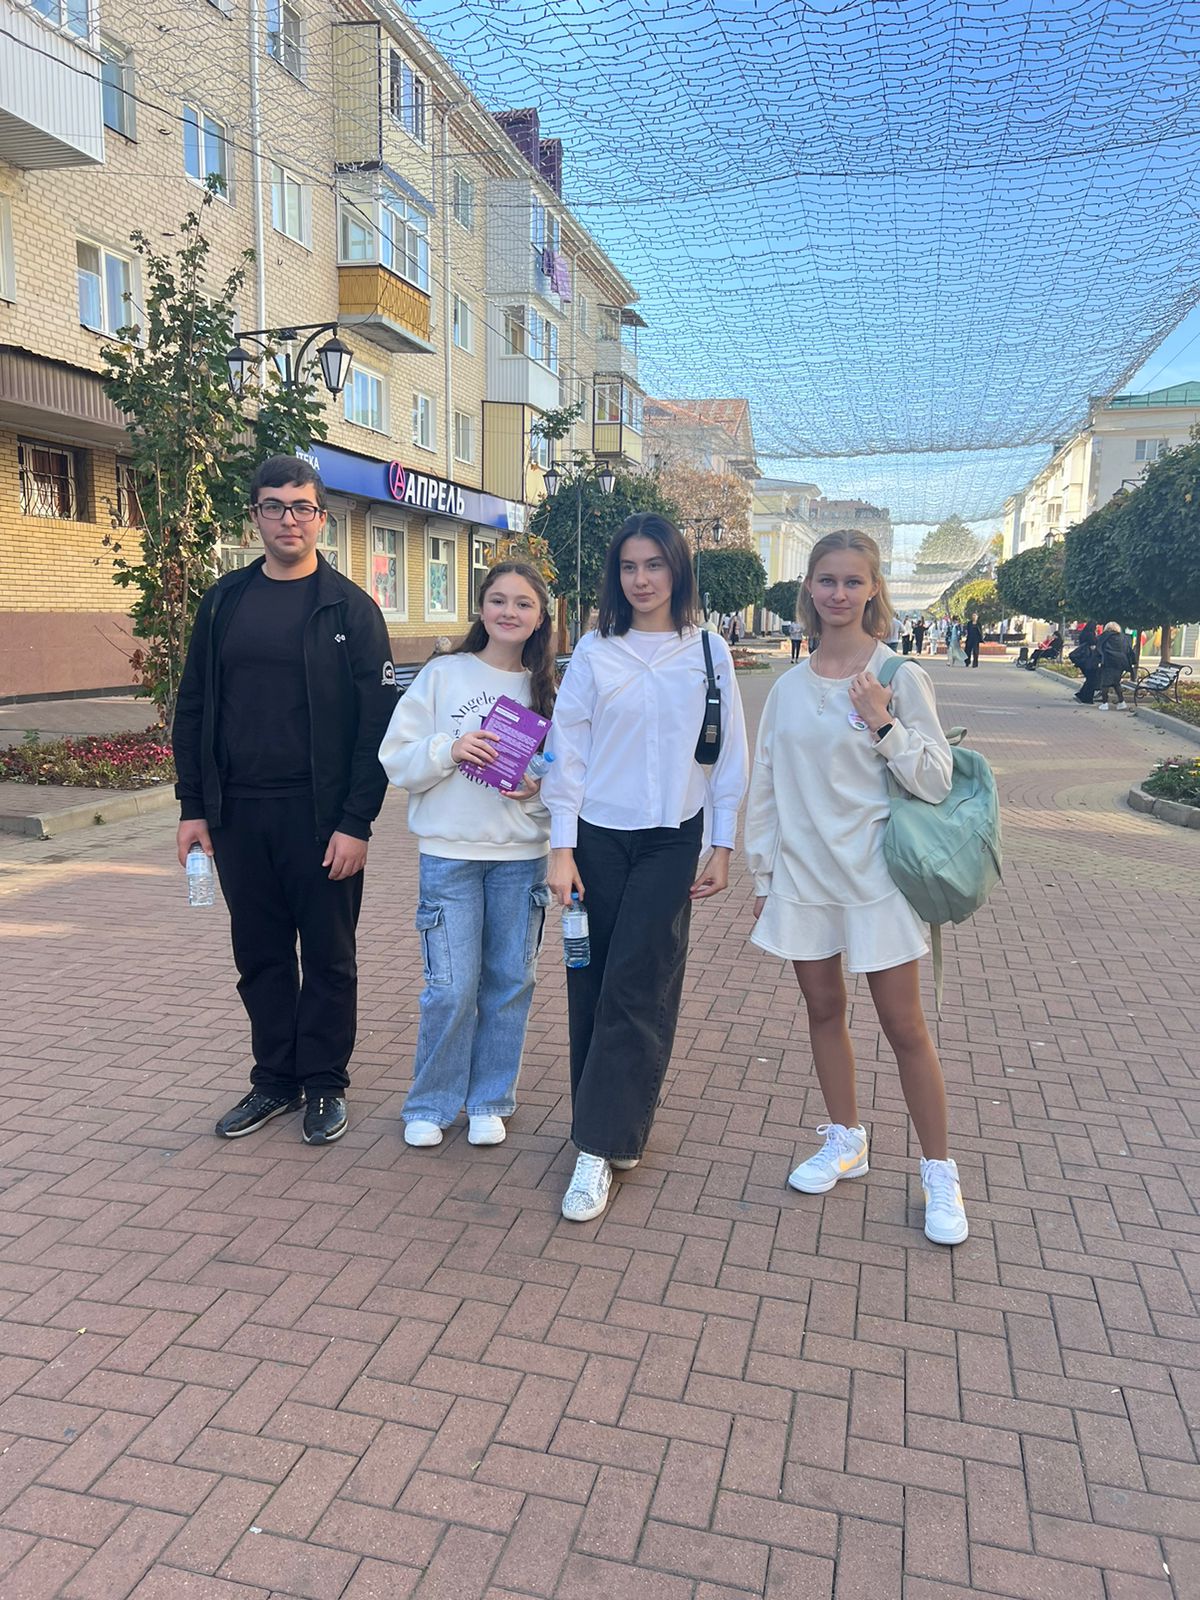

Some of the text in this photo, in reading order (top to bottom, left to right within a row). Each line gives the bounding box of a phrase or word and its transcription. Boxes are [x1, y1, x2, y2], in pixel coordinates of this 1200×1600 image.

[295, 451, 320, 471] ТЕКА
[404, 472, 465, 516] АПРЕЛЬ
[450, 690, 496, 726] Angele
